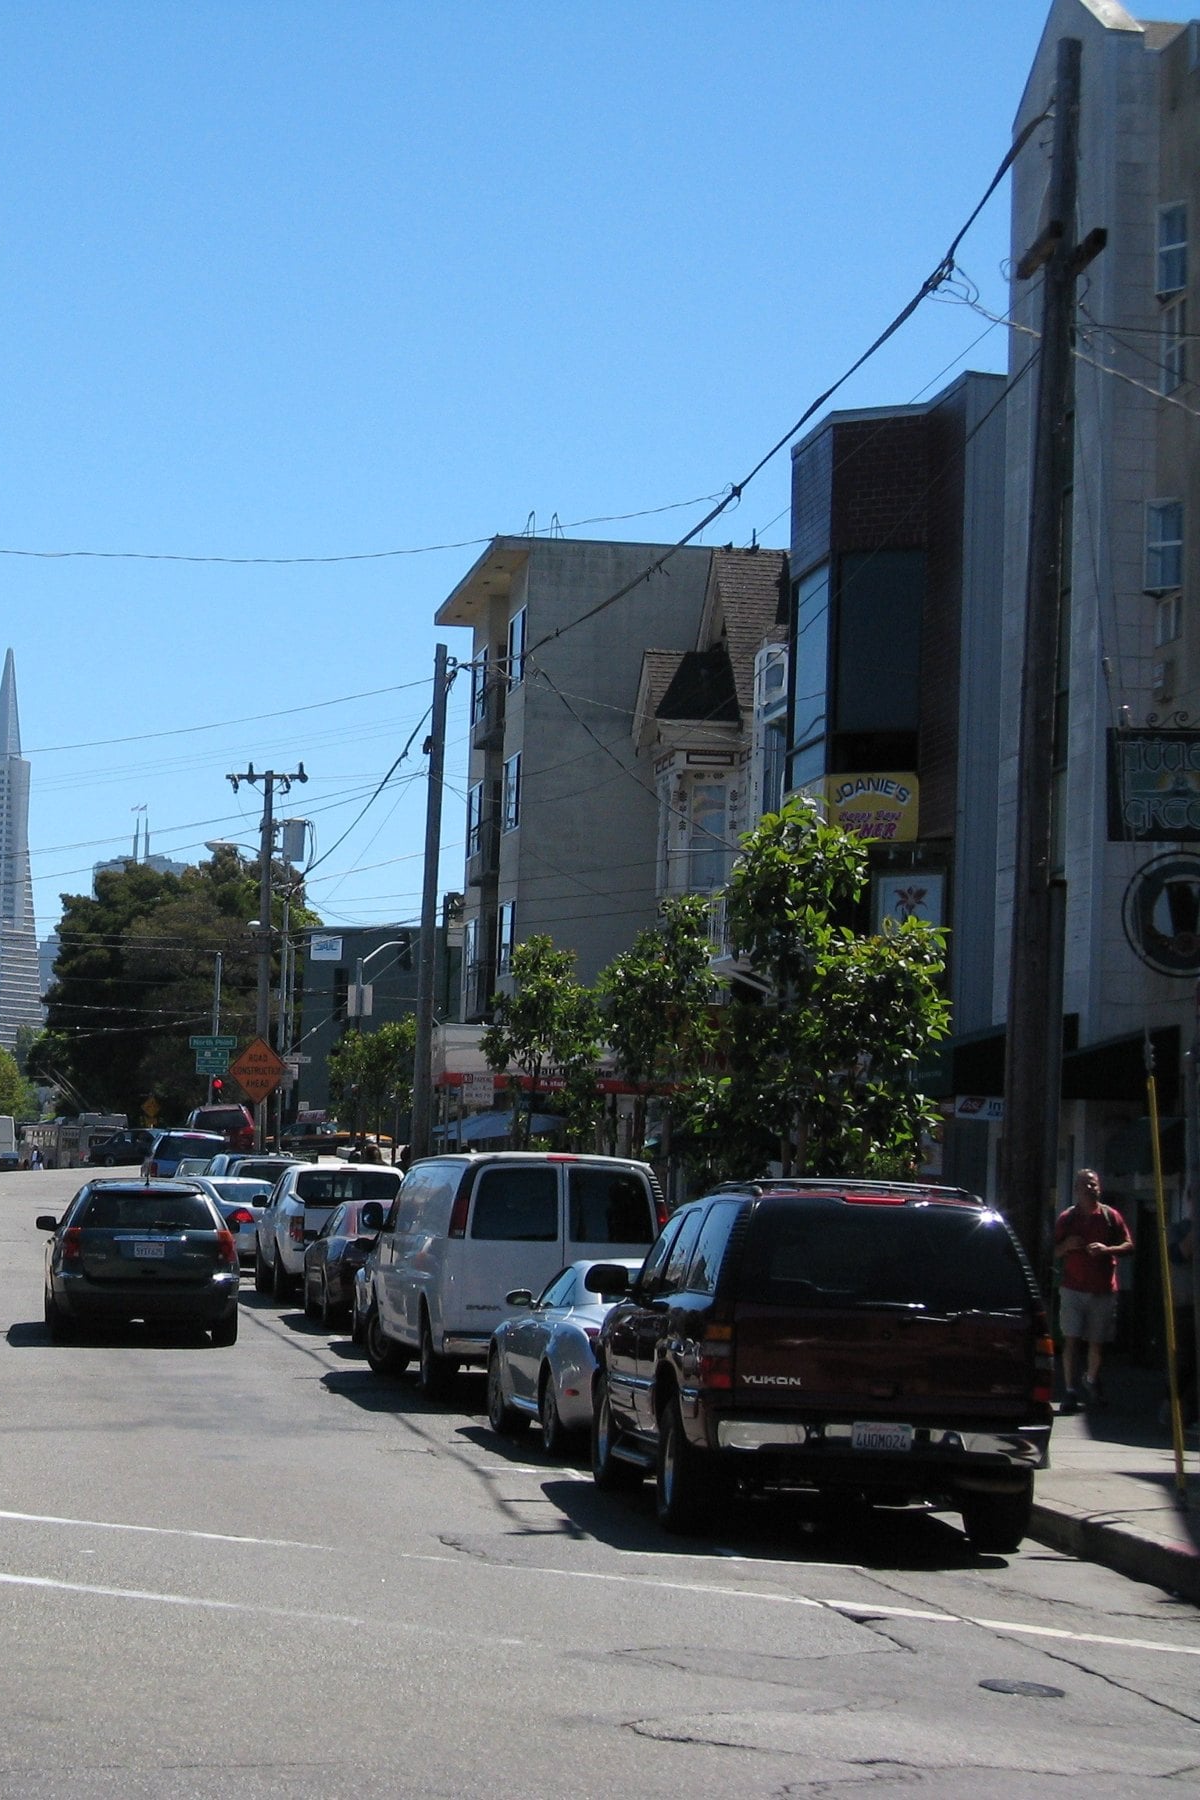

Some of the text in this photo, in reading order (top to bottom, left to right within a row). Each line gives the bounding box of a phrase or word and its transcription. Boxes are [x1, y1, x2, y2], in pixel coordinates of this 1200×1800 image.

[834, 777, 911, 807] JOANIE'S
[843, 822, 898, 839] DNER
[193, 1038, 233, 1047] North Point
[248, 1054, 268, 1062] ROAD
[245, 1079, 269, 1088] AHEAD
[741, 1375, 801, 1386] YUKON
[856, 1432, 907, 1449] 4UDM024
